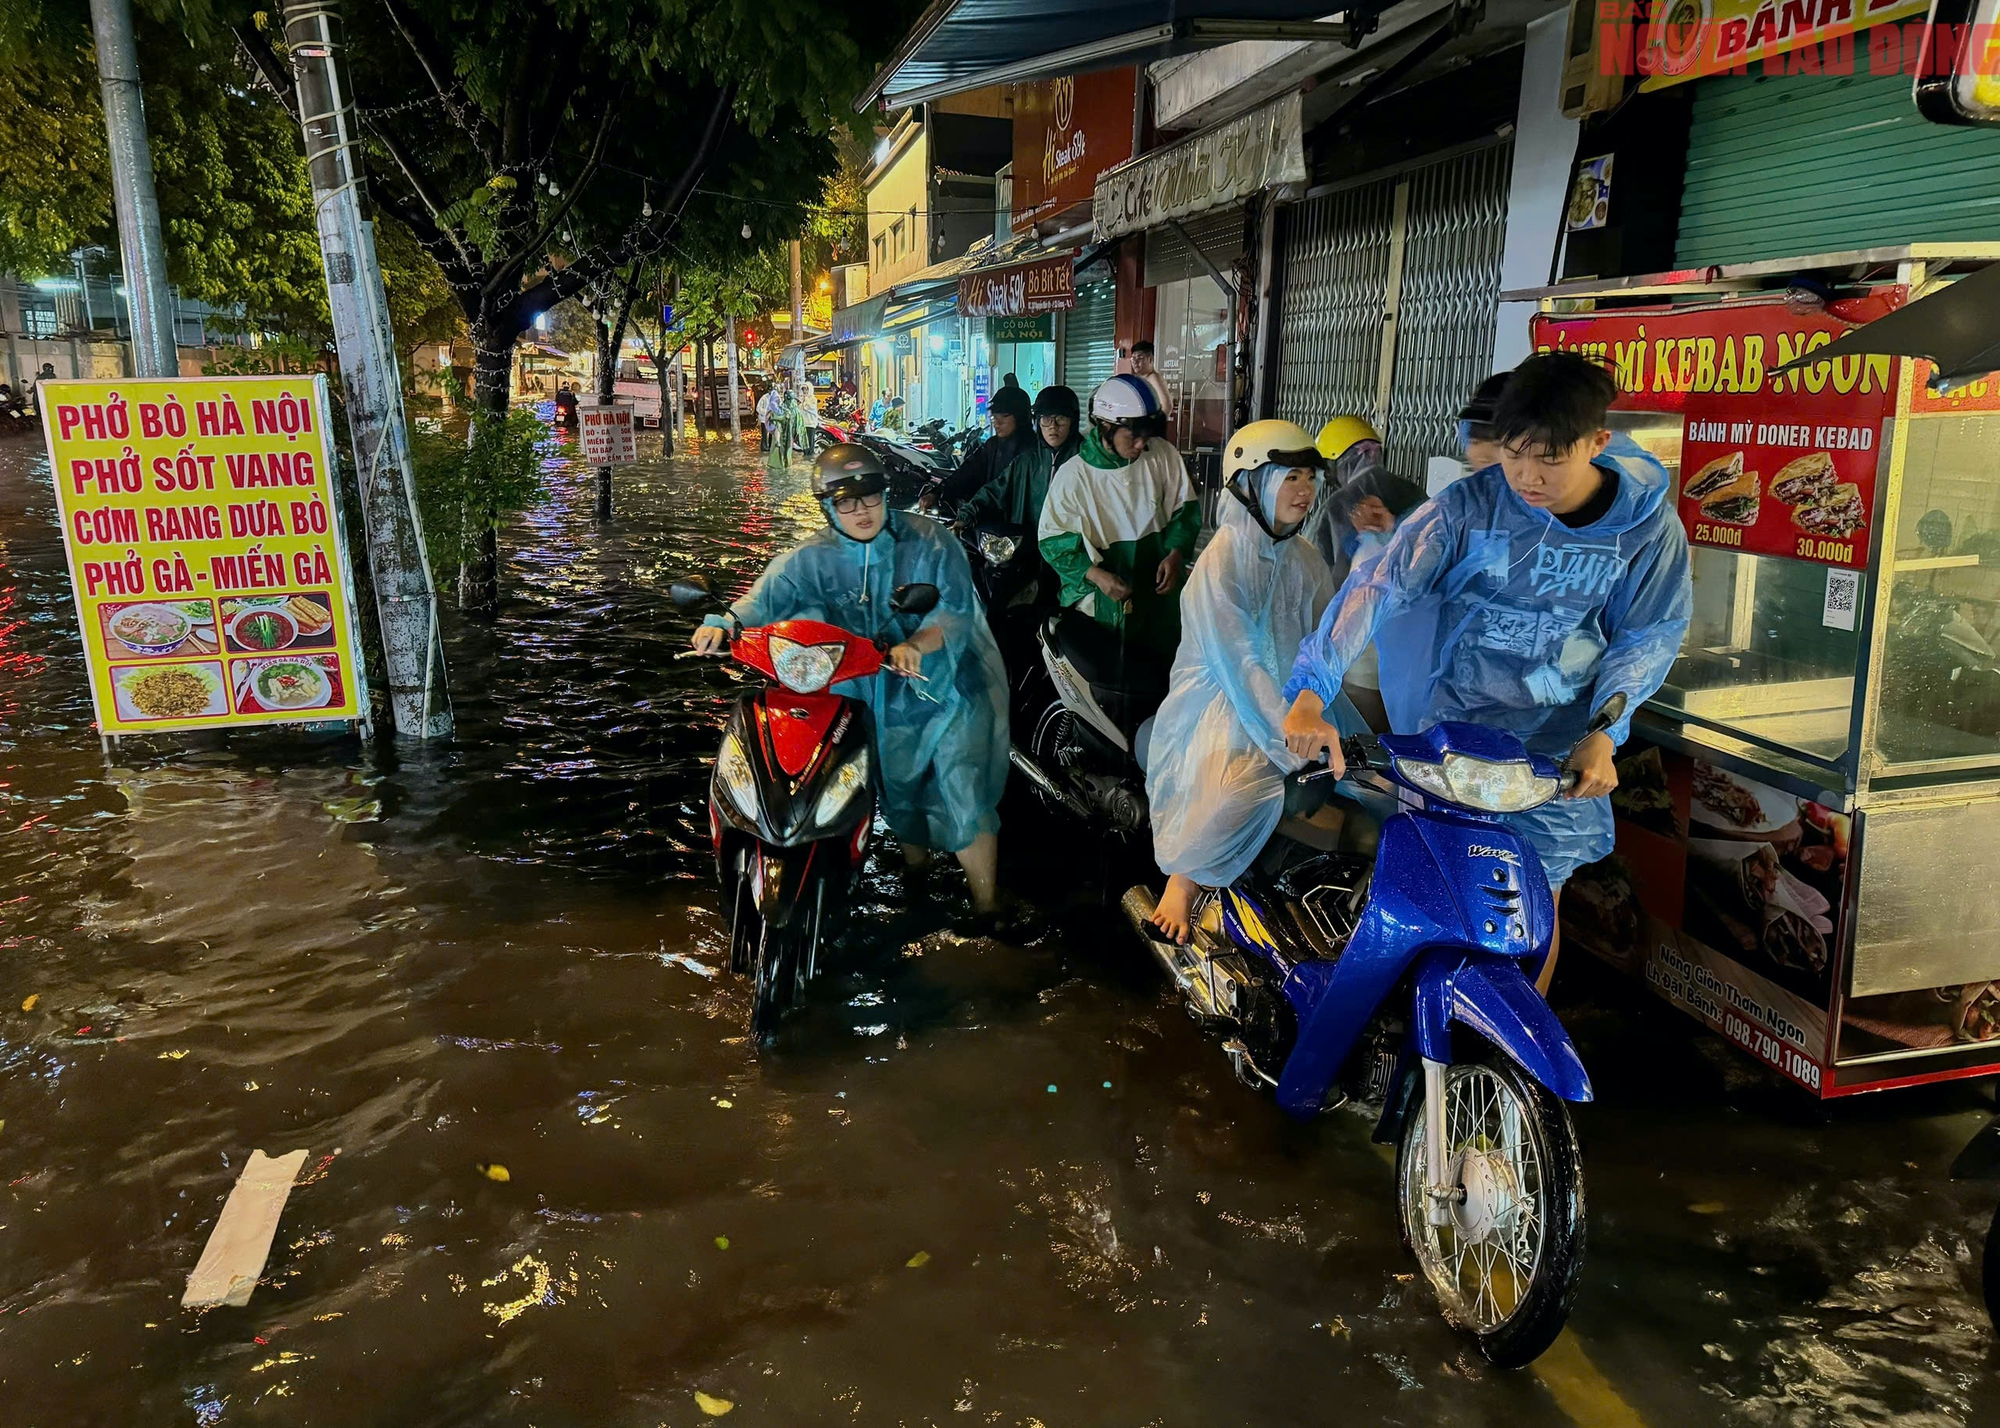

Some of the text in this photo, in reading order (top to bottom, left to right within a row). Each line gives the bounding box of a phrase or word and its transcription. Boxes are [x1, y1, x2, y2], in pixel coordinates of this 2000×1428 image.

[1716, 0, 1852, 59] BÁNH
[1043, 126, 1057, 185] Hi
[1056, 143, 1072, 169] Steak
[968, 275, 985, 307] Hi
[986, 273, 1009, 315] Steak
[1028, 270, 1039, 293] Bò
[1041, 268, 1054, 292] Bít
[1055, 262, 1070, 291] Tết
[996, 328, 1044, 339] HÀ NỘI
[1003, 319, 1036, 329] CÔ ĐÀO
[1614, 324, 1648, 393] MÌ
[1653, 333, 1764, 394] KEBAB
[57, 391, 312, 442] PHỞ BÒ HÀ NỘI
[584, 410, 601, 426] PHỞ
[603, 411, 615, 425] HÀ
[616, 410, 630, 426] NỘI
[1688, 418, 1873, 451] BÁNH MỲ DONER KEBAD
[72, 443, 315, 494] PHỞ SỐT VANG
[74, 493, 328, 545] CƠM RANG DƯA BÒ
[1695, 523, 1742, 546] 25.000đ
[84, 550, 145, 597] PHỞ
[153, 551, 194, 593] GÀ
[211, 544, 286, 590] MIẾN
[293, 544, 333, 586] GÀ
[1797, 537, 1854, 563] 30.000đ
[1659, 943, 1692, 981] Nóng
[1725, 982, 1764, 1022] Thơm
[1766, 1007, 1806, 1046] Ngon
[1661, 972, 1684, 1000] Đặt
[1686, 986, 1723, 1025] Bánh:
[1724, 1013, 1821, 1091] 098.790.1089
